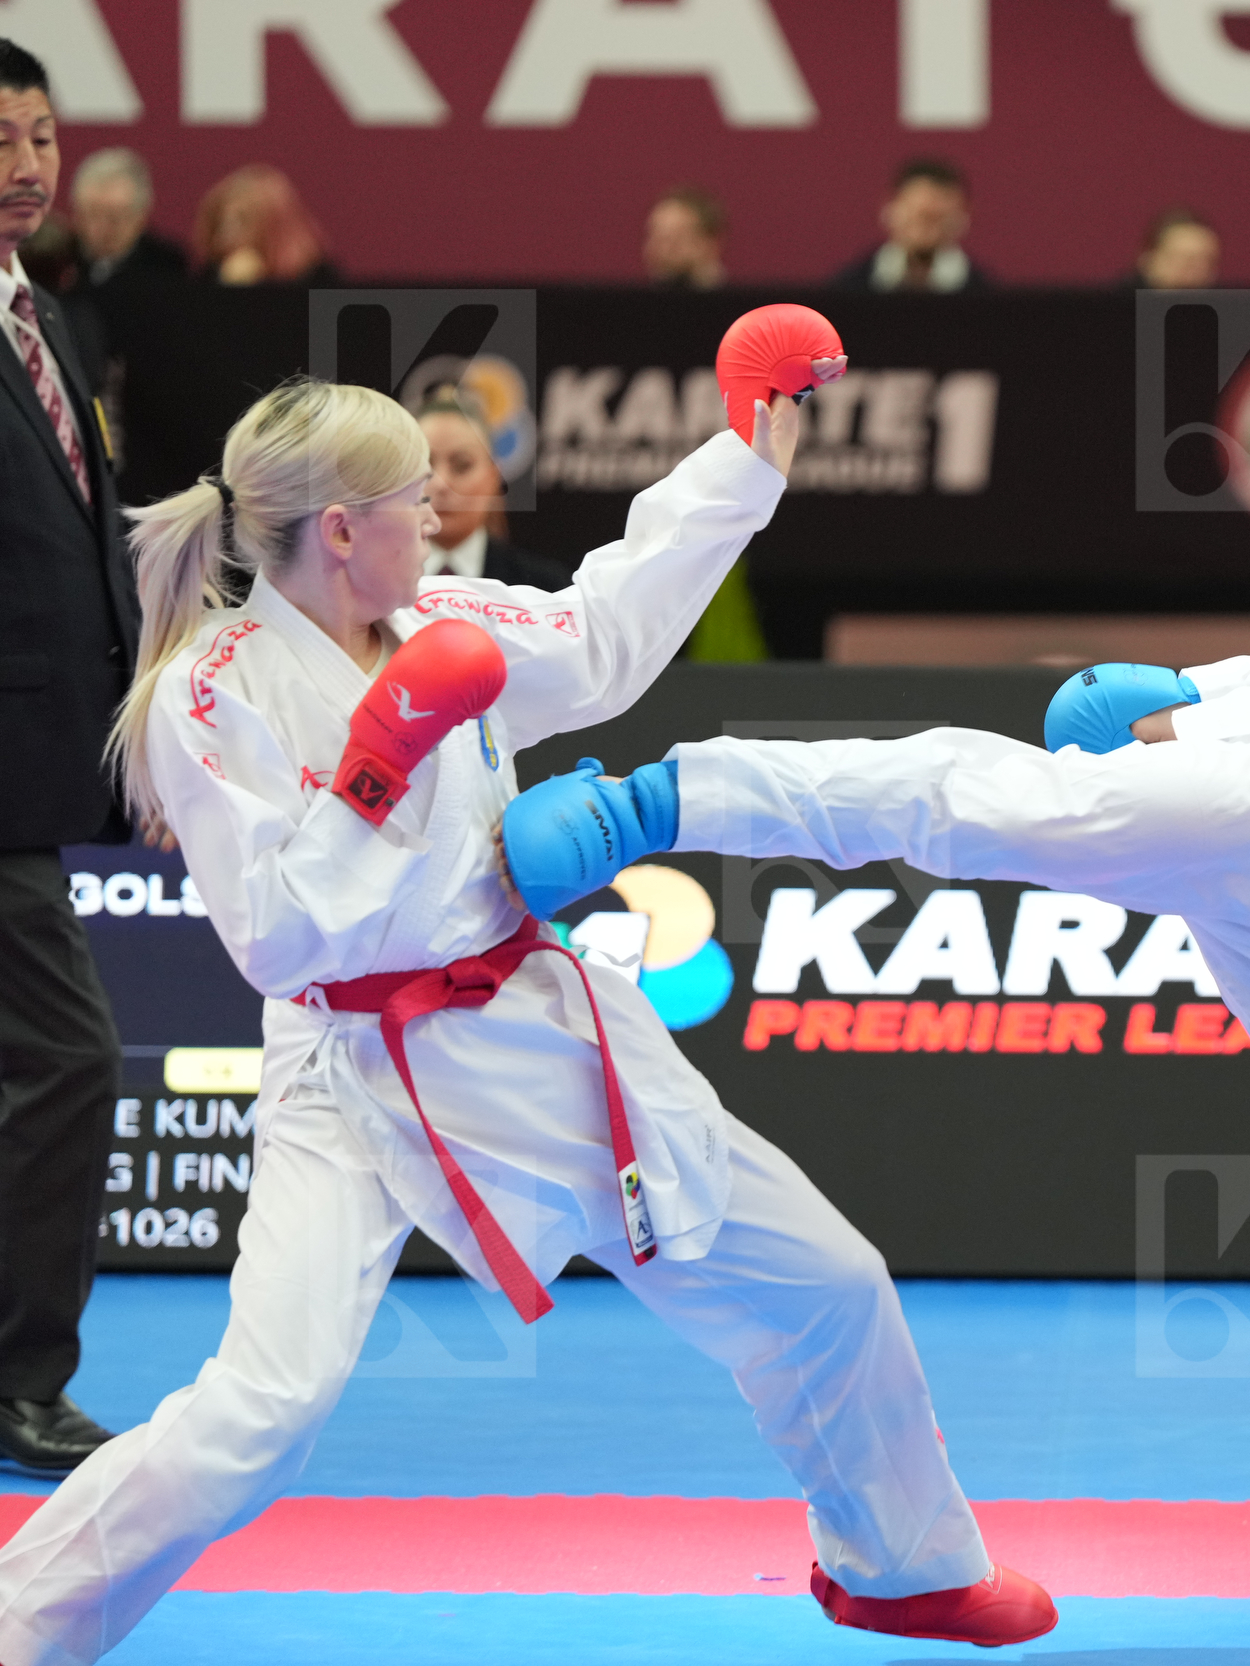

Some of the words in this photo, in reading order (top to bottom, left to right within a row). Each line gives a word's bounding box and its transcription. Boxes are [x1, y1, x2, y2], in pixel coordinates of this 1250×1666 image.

[541, 366, 932, 444] KARTE
[752, 888, 1222, 997] KARA
[743, 1000, 1106, 1053] PREMIER
[173, 1153, 252, 1193] FIN
